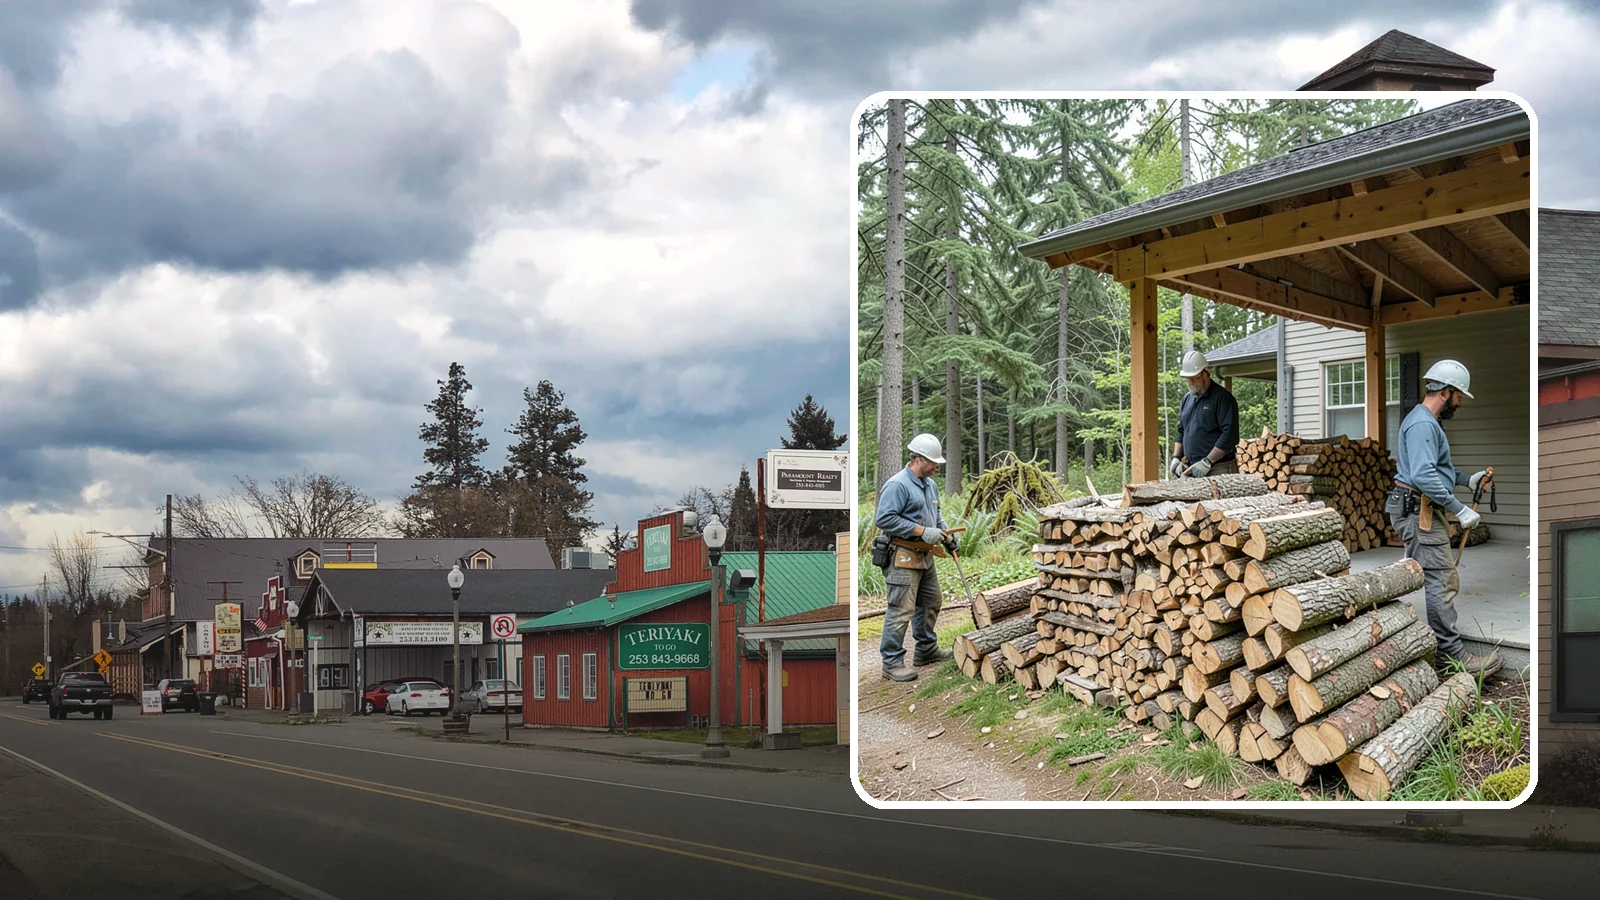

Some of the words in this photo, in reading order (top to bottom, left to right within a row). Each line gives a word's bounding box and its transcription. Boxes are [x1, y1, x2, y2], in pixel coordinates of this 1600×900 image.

[625, 627, 702, 646] TERIYAKI
[628, 654, 648, 664] 253
[652, 653, 700, 664] 843-9668
